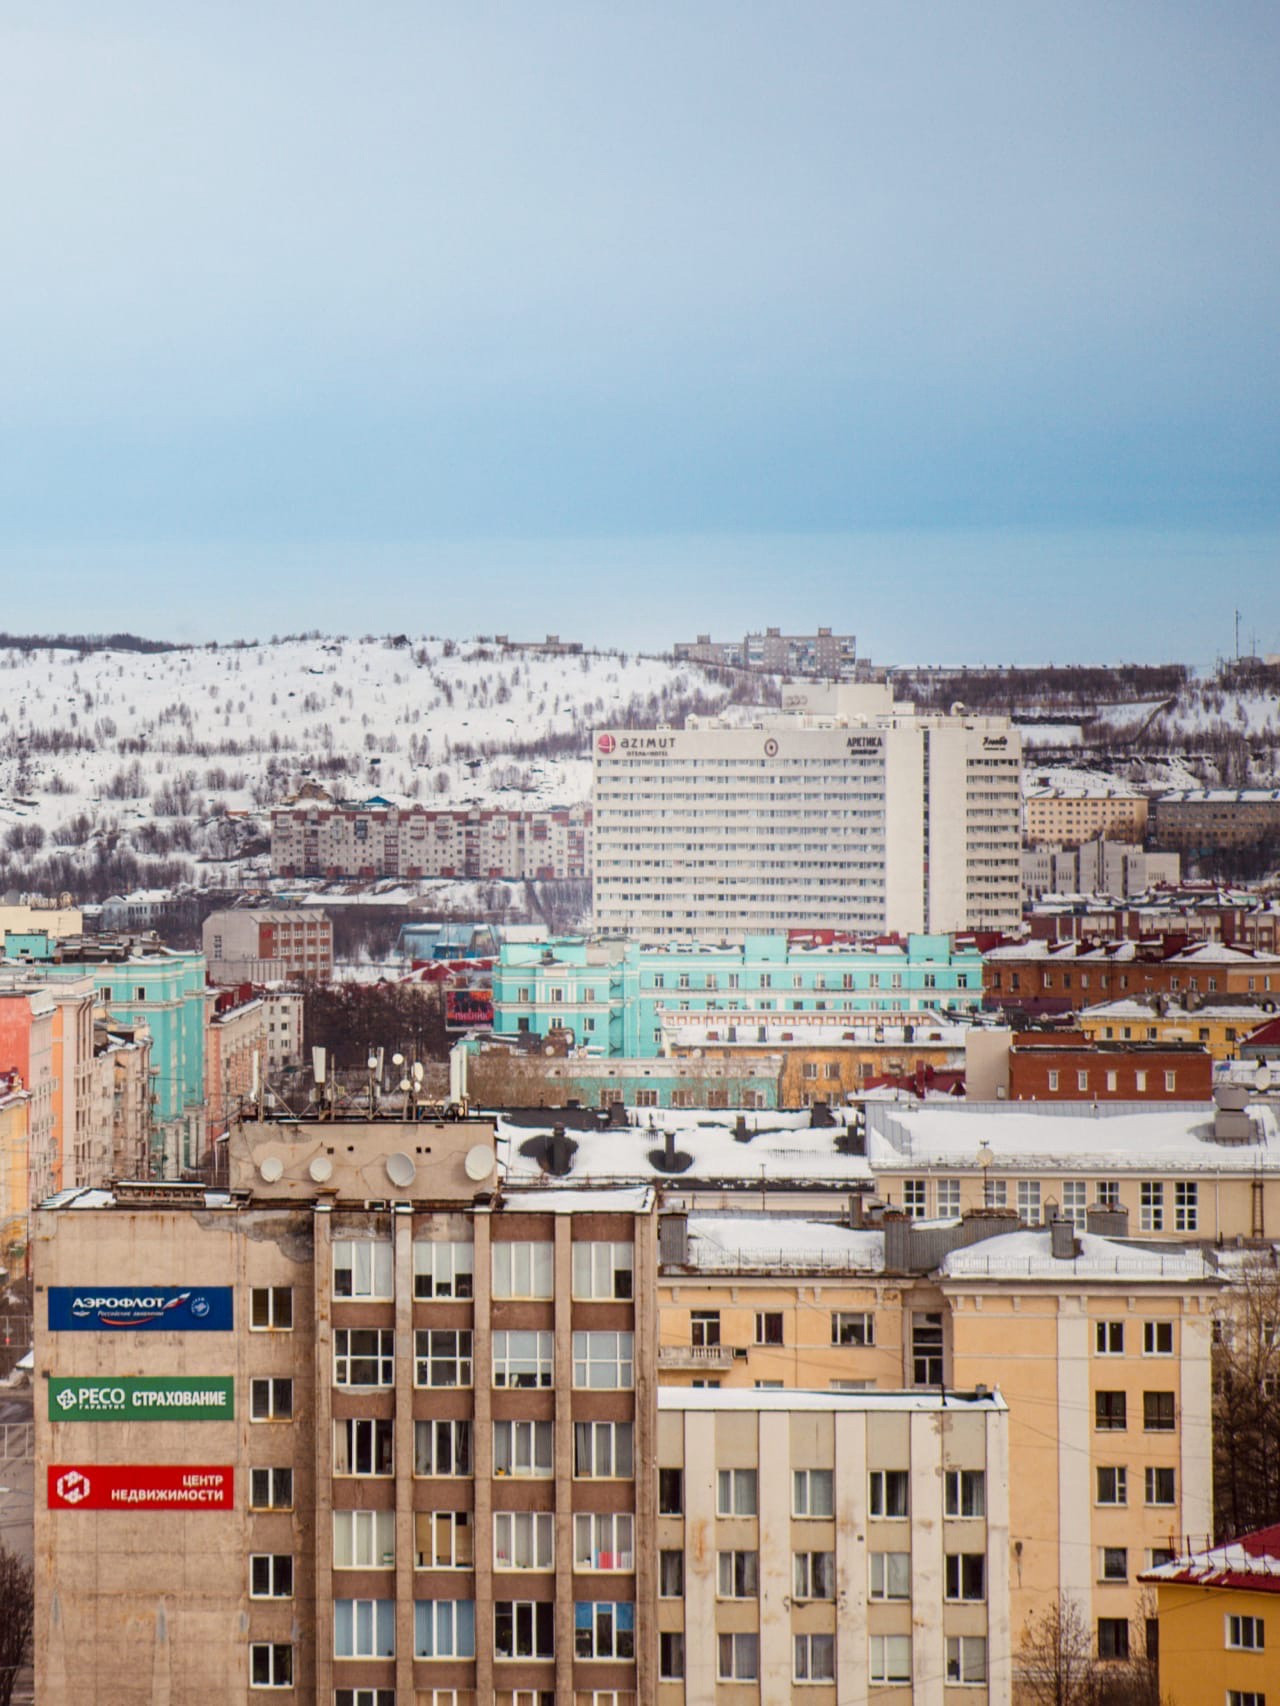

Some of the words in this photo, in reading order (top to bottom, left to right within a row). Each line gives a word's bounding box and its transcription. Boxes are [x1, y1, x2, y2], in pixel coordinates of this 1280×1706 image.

[846, 736, 883, 747] АРКТИКА
[72, 1297, 165, 1308] АЭРОФЛОТ
[78, 1388, 126, 1404] РЕСО
[132, 1391, 227, 1406] СТРАХОВАНИЕ
[182, 1474, 224, 1488] ЦЕНТР
[111, 1489, 224, 1503] НЕДВИЖИМОСТИ
